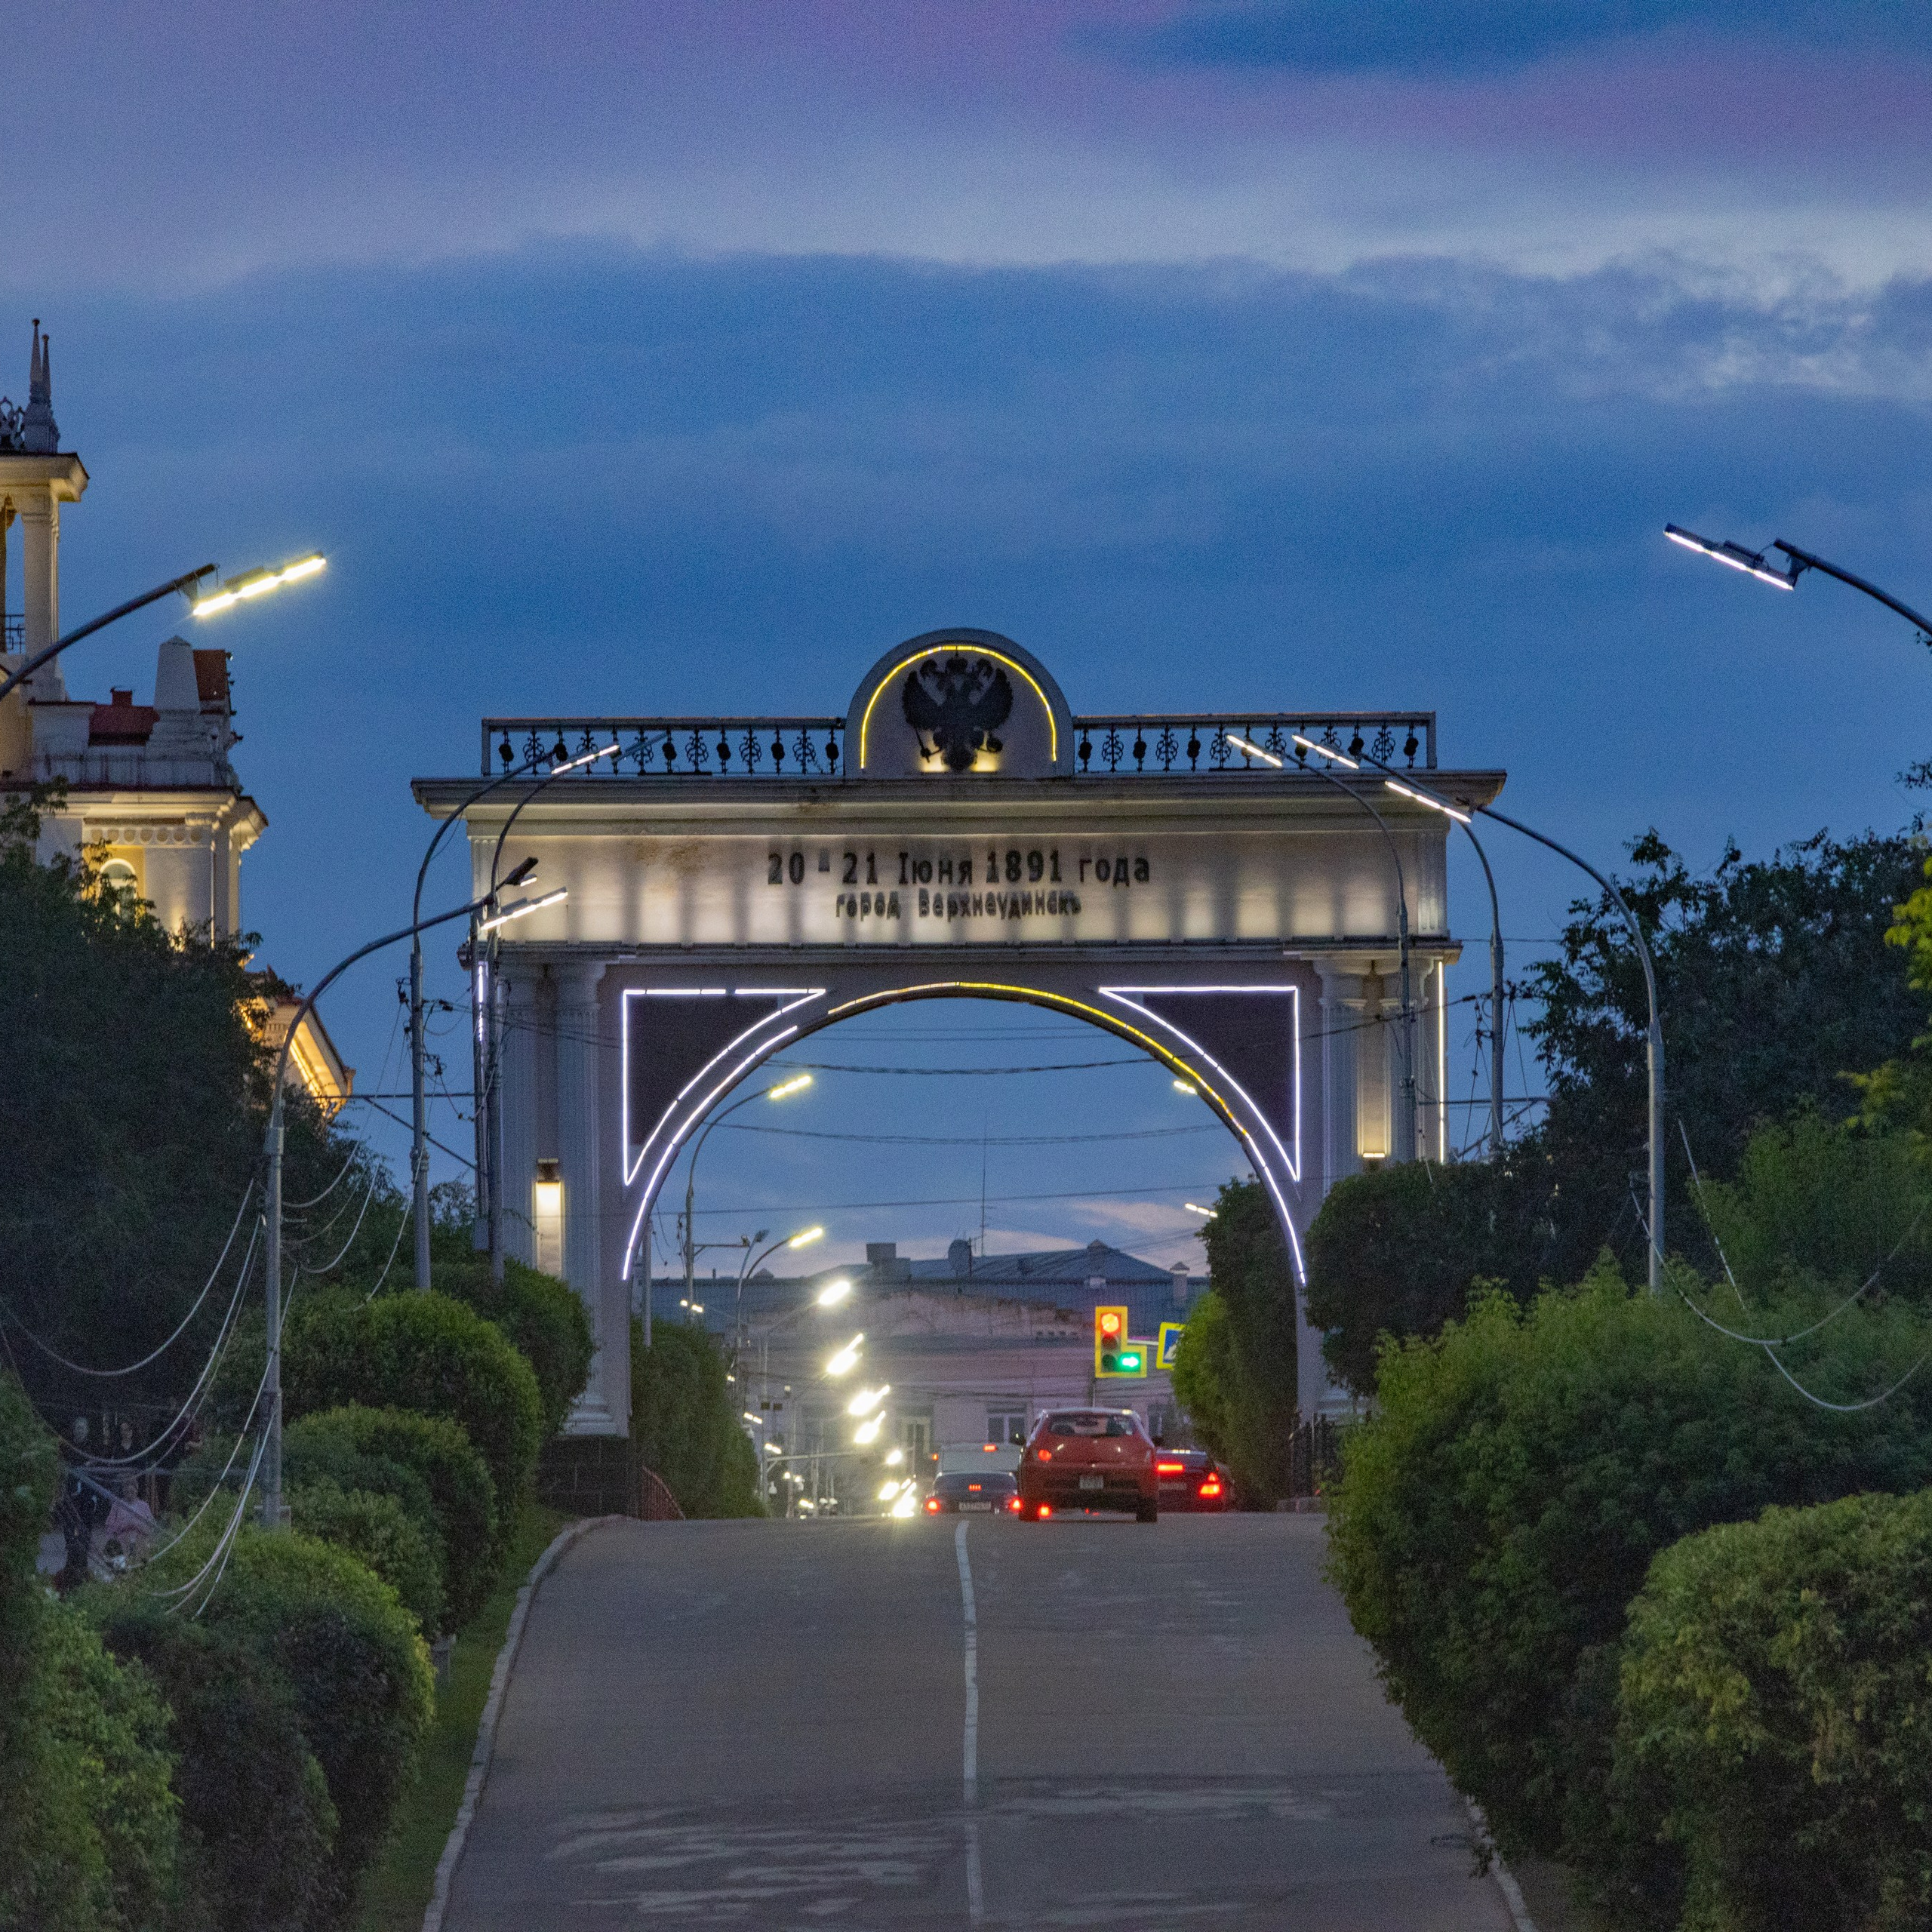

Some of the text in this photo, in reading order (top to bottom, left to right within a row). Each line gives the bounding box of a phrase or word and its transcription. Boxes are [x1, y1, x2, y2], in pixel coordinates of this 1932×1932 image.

[768, 851, 805, 884] 20
[842, 851, 878, 884] 21
[986, 850, 1062, 883] 1891
[1079, 857, 1150, 888] года
[835, 891, 900, 921] город
